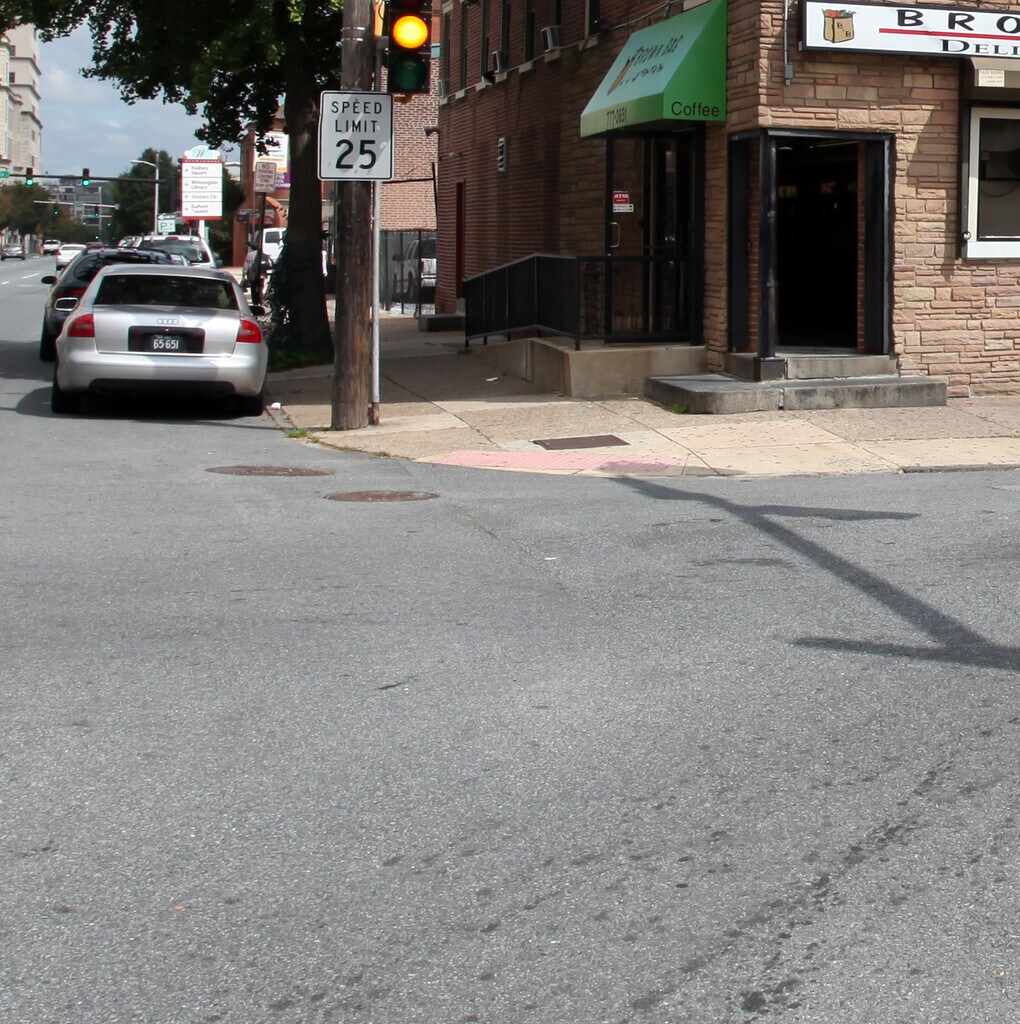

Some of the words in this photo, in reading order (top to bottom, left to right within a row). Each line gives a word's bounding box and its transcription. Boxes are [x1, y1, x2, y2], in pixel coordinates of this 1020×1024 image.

[331, 101, 382, 114] SPEED
[671, 101, 720, 117] Coffee
[335, 119, 378, 133] LIMIT
[335, 139, 377, 170] 25
